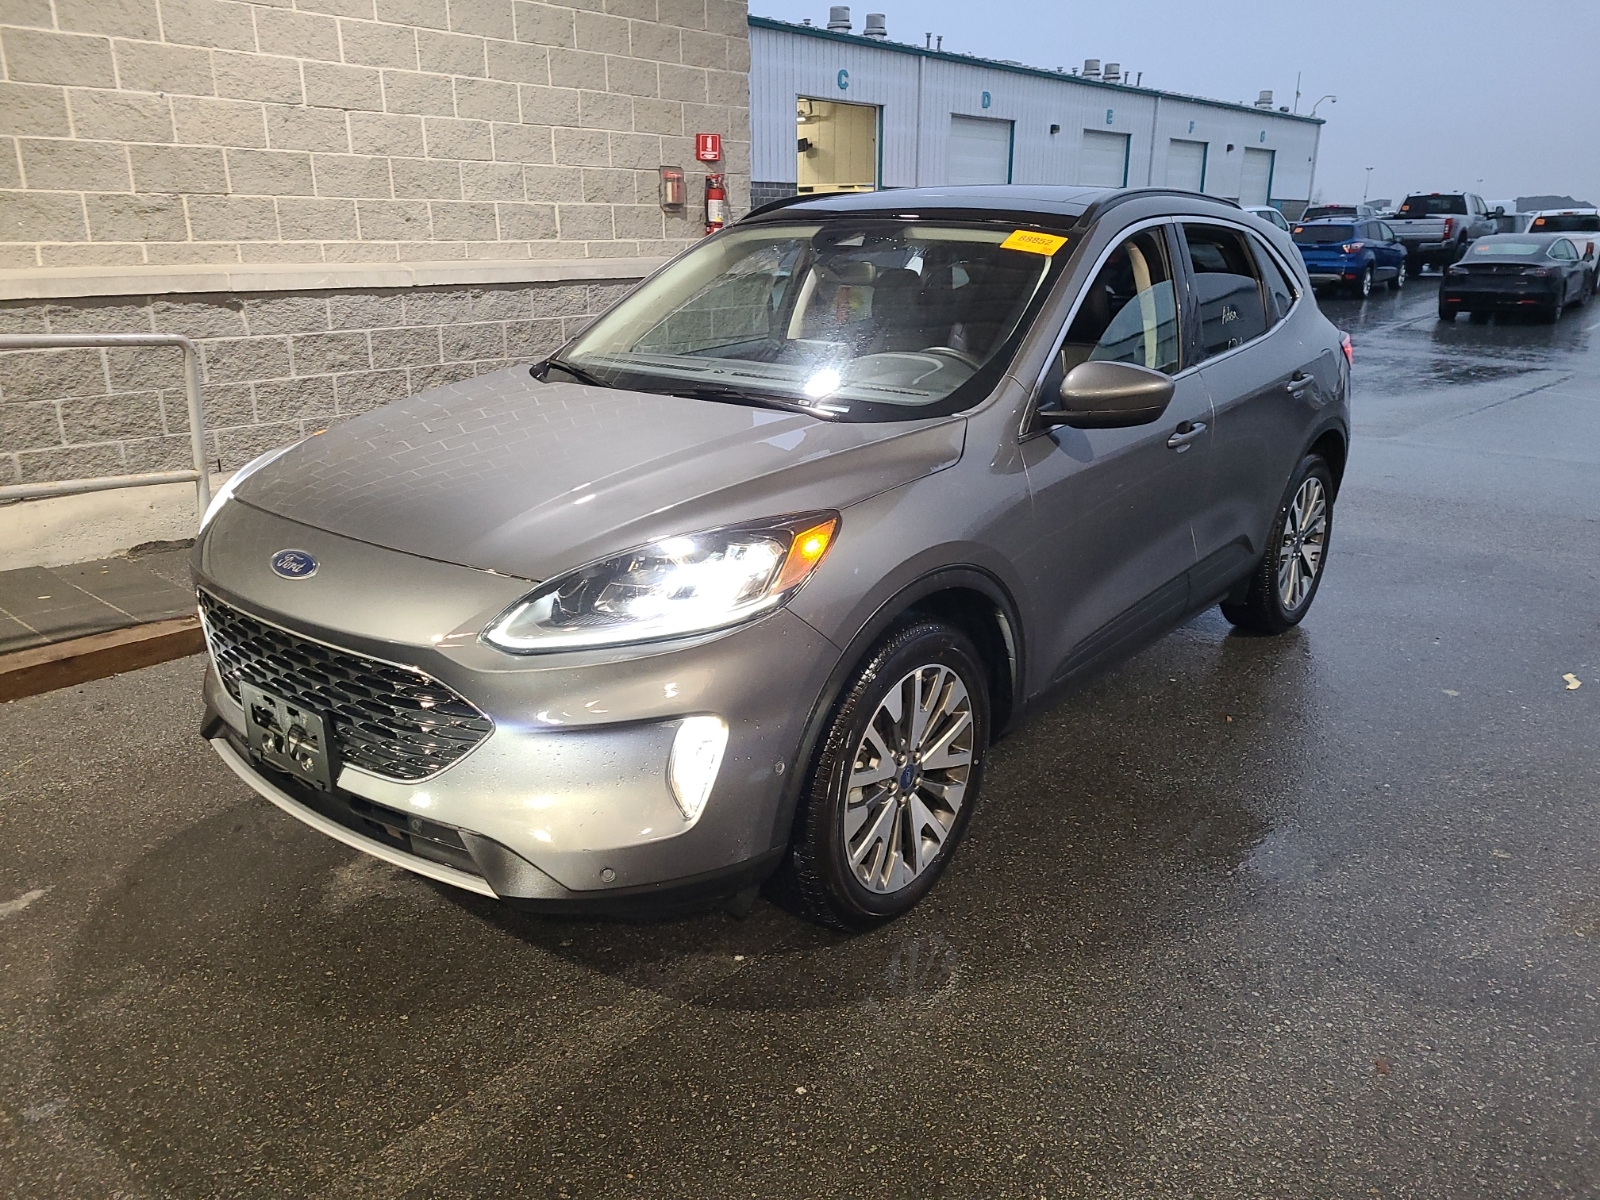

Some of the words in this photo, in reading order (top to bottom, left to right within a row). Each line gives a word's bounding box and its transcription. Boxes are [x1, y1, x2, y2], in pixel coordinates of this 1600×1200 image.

[837, 69, 849, 90] C
[981, 91, 991, 109] D
[1106, 109, 1113, 125] E
[1188, 121, 1195, 134] F
[1260, 130, 1266, 143] G
[276, 553, 307, 573] Ford
